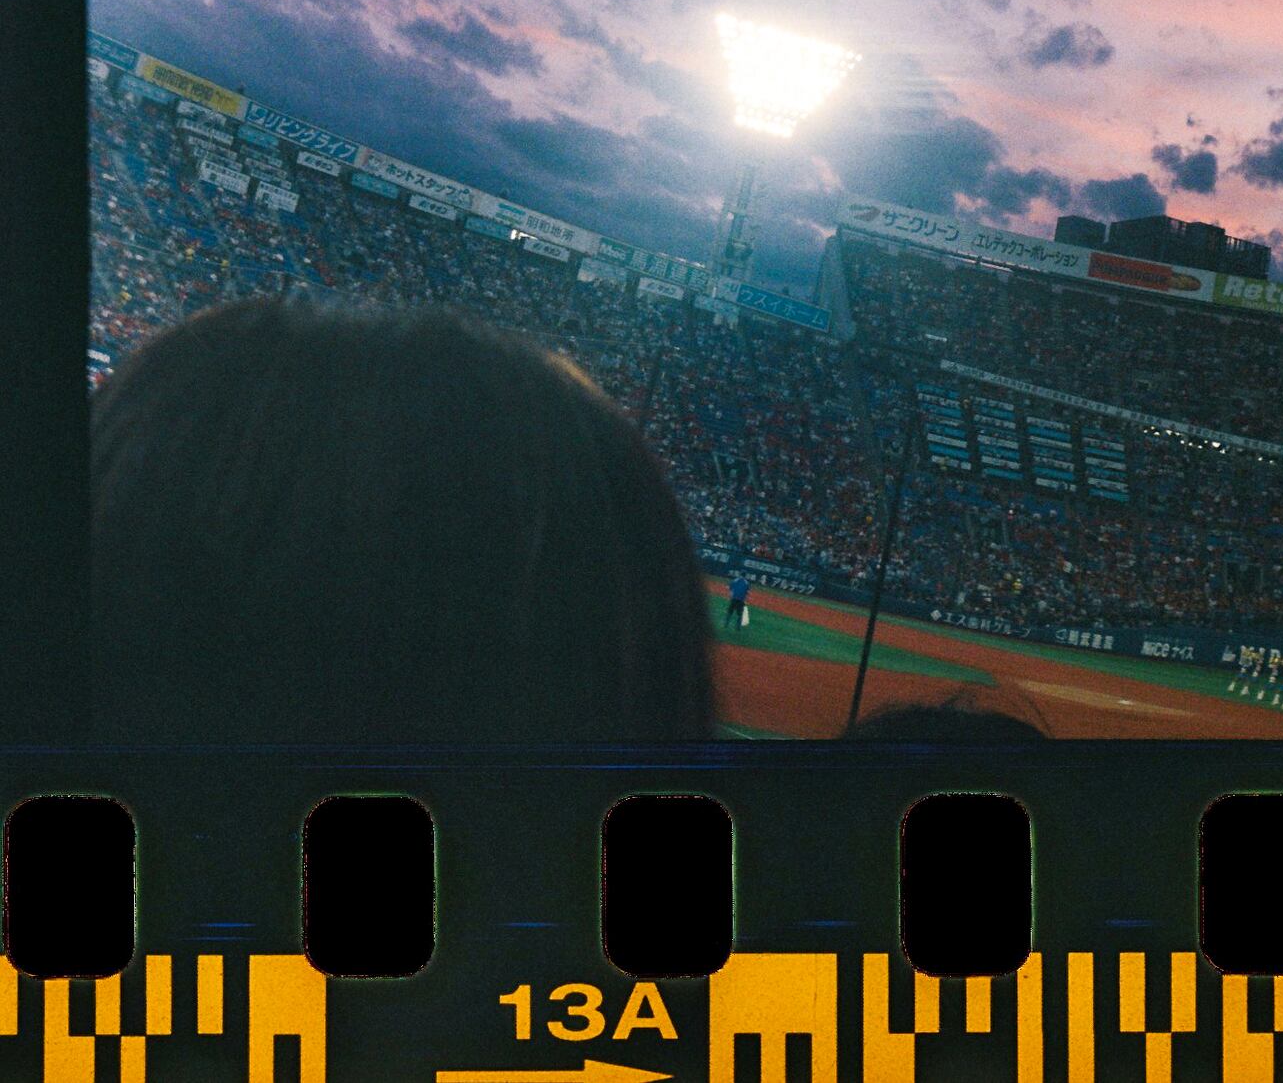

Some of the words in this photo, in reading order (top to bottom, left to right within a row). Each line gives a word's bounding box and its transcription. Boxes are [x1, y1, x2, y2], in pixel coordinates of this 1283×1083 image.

[385, 162, 457, 196] ホットスタッフ
[882, 208, 960, 243] サニクリーン
[499, 981, 679, 1042] 13A
